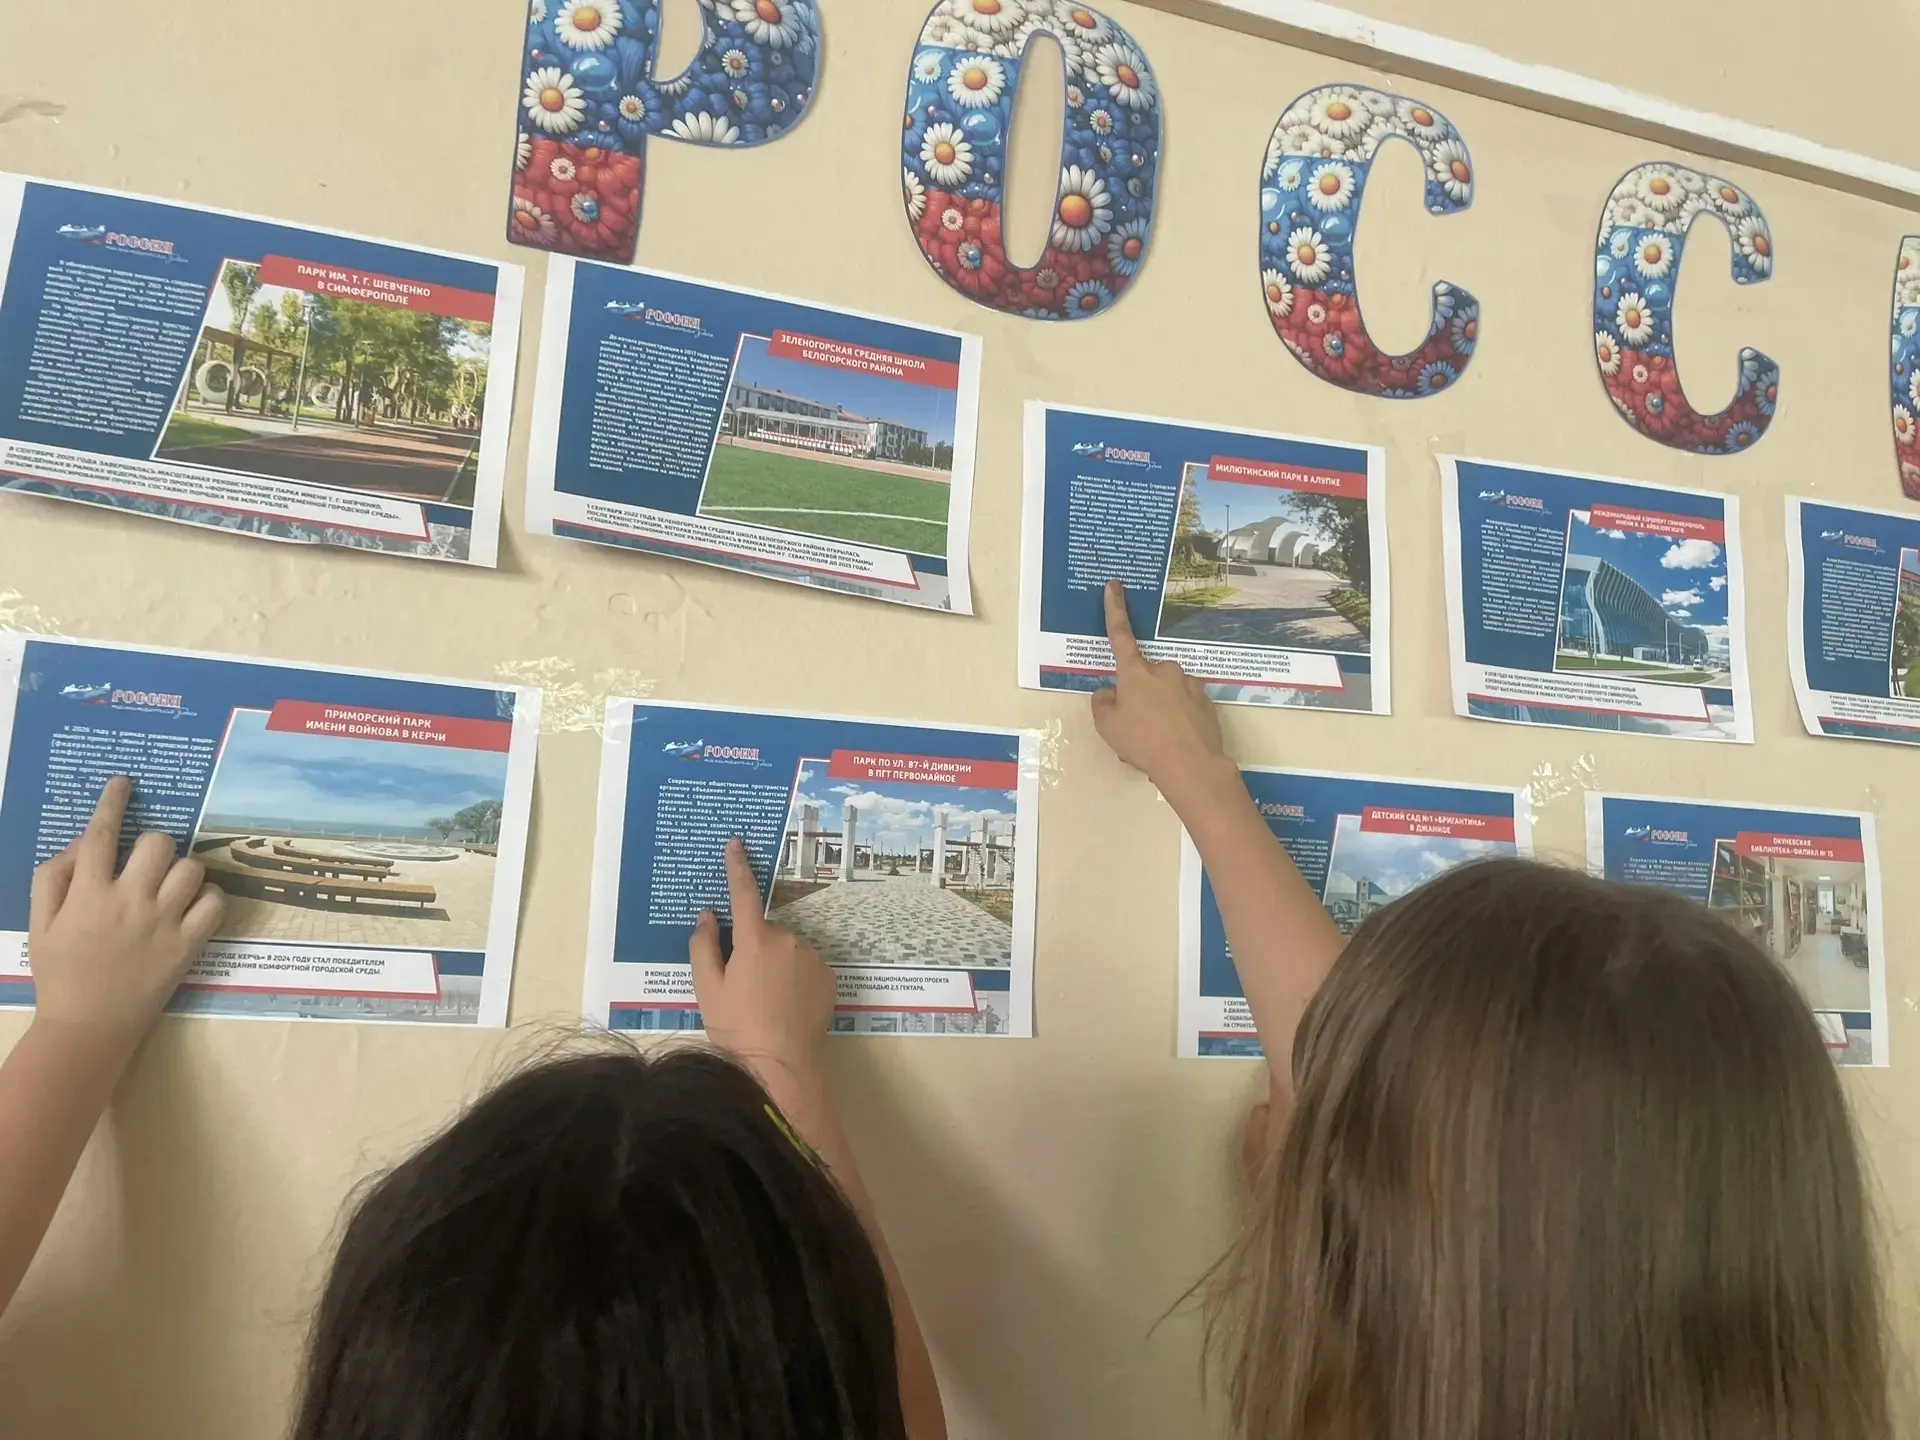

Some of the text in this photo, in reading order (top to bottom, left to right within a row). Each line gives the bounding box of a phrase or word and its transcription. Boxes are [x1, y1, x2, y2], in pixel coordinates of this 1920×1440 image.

[104, 230, 174, 255] РОССИЯ
[507, 0, 1920, 502] РОСС
[296, 264, 431, 297] ПАРК ИМ. Т. Г. ШЕВЧЕНКО
[316, 280, 408, 304] В СИМФЕРОПОЛЕ
[644, 307, 700, 330] РОССИЯ
[780, 333, 925, 370] ЗЕЛЕНОГОРСКАЯ СРЕДНЯЯ ШКОЛА
[802, 349, 903, 376] БЕЛОГОРСКОГО РАЙОНА
[1104, 446, 1150, 463] РОССИЯ
[1215, 463, 1340, 486] МИЛЮТИНСКИЙ ПАРК В АЛУПКЕ
[585, 508, 608, 518] ПОСЛЕ
[663, 523, 692, 533] КОТОРАЯ
[741, 537, 767, 547] РАМКАХ
[810, 549, 837, 560] ЦЕЛЕВОЙ
[837, 554, 874, 567] ПРОГРАММЫ
[590, 504, 622, 514] СЕНТЯБРЯ
[623, 510, 638, 518] 2022
[639, 513, 656, 521] ГОДА
[707, 526, 735, 535] СРЕДНЯЯ
[735, 530, 758, 540] ШКОЛА
[802, 542, 825, 551] РАЙОНА
[825, 546, 860, 557] ОТКРЫЛАСЬ
[686, 532, 717, 544] РАЗВИТИЕ
[757, 545, 776, 555] КРЫМ
[837, 560, 852, 569] 2025
[1065, 637, 1094, 645] ОСНОВНЫЕ
[1179, 653, 1208, 661] ГОРОДСКОЙ
[110, 688, 182, 709] РОССИЯ
[323, 709, 432, 728] ПРИМОРСКИЙ ПАРК
[304, 720, 446, 741] ИМЕНИ ВОЙКОВА В КЕРЧИ
[703, 744, 759, 761] РОССИЯ
[852, 756, 972, 772] ПАРК ПО УЛ. 87-Й ДИВИЗИИ
[867, 768, 956, 782] В ПГТ ПЕРВОМАЙКОЕ
[658, 784, 689, 792] органично
[728, 788, 757, 796] элементы
[758, 790, 787, 798] советской
[1371, 810, 1404, 820] ДЕТСКИЙ
[1406, 813, 1420, 822] САД
[1422, 814, 1432, 822] №1
[1409, 823, 1451, 833] В ДЖАНКОЕ
[1650, 829, 1687, 842] РОССИЯ
[200, 950, 207, 958] В
[237, 952, 266, 961] КЕРЧЬ»
[266, 953, 272, 961] В
[272, 954, 291, 962] 2024
[291, 954, 311, 963] ГОДУ
[311, 955, 331, 964] СТАЛ
[216, 960, 257, 970] СОЗДАНИЯ
[310, 964, 354, 974] ГОРОДСКОЙ
[354, 966, 383, 975] СРЕДЫ.
[848, 974, 873, 982] РАМКАХ
[853, 982, 889, 991] ПЛОЩАДЬЮ
[899, 984, 925, 992] ГЕКТАРА.
